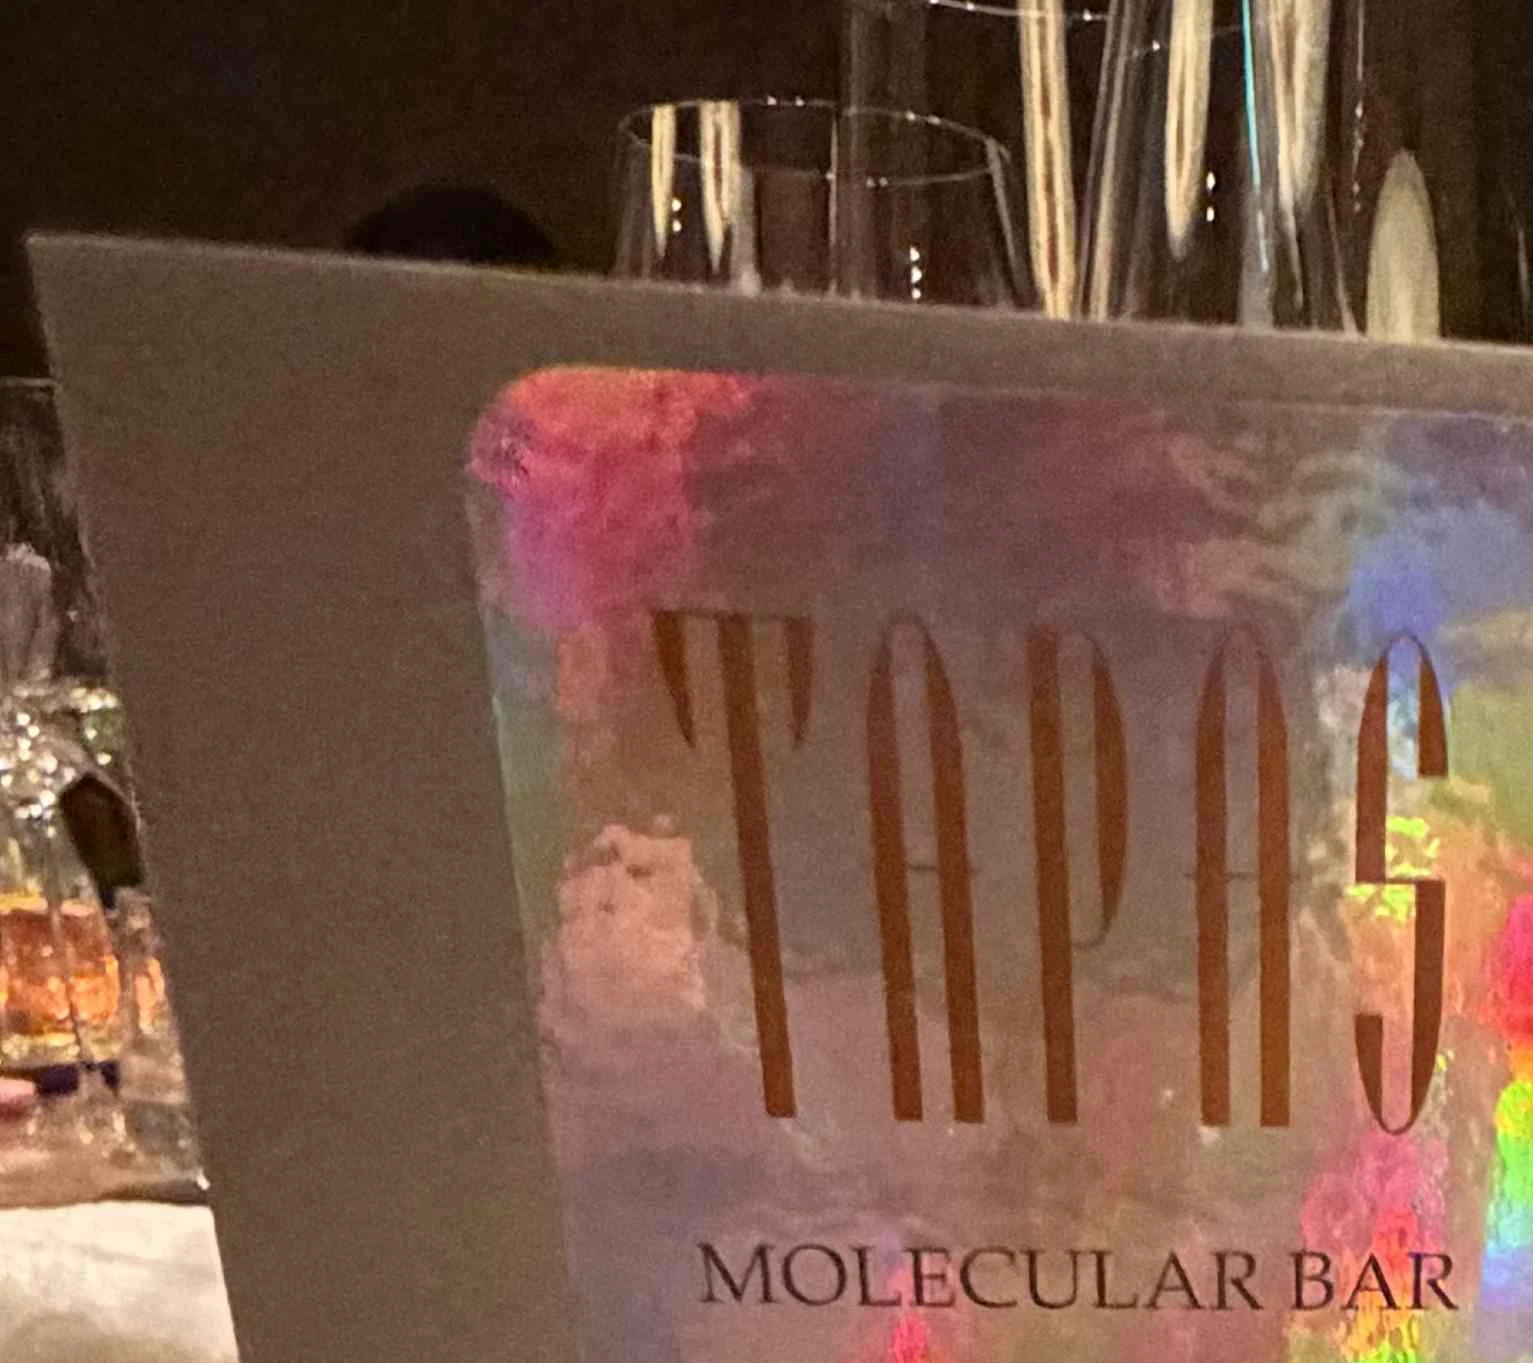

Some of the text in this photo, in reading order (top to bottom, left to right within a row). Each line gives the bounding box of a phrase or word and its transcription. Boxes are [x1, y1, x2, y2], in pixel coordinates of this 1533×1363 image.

[650, 610, 1447, 1135] TAPAS
[698, 1243, 1460, 1314] MOLECULAR BAR
